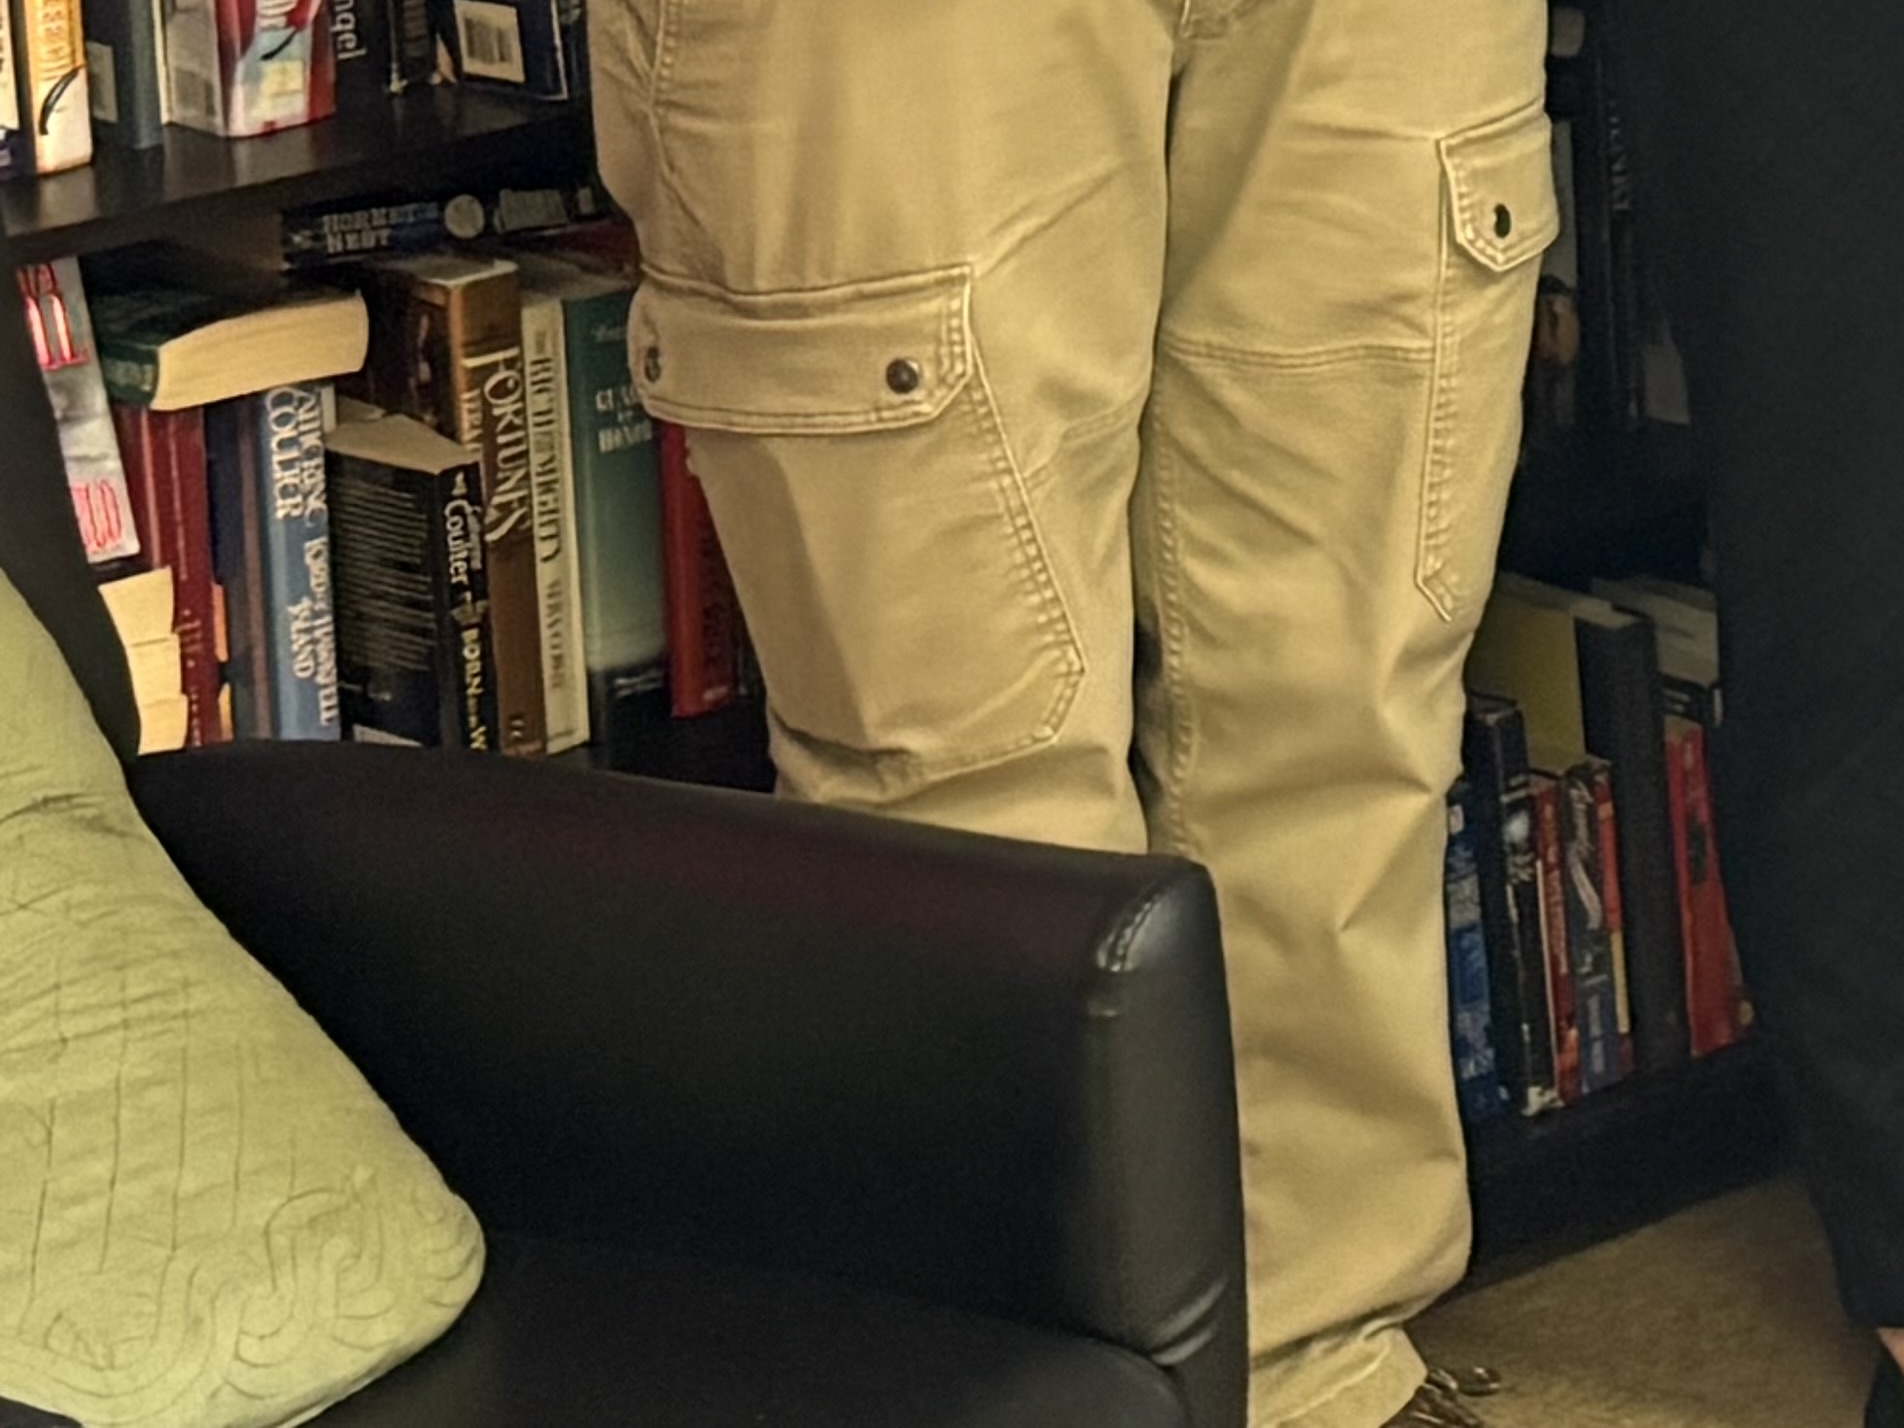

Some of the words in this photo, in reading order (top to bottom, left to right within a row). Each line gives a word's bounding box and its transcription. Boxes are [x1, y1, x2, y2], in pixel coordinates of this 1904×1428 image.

[264, 385, 306, 520] COULTER
[461, 347, 531, 544] FORTUNES
[530, 355, 559, 428] RICH
[296, 391, 329, 528] CATHERINE
[535, 453, 561, 566] MIGHTY
[444, 499, 473, 586] Coulter
